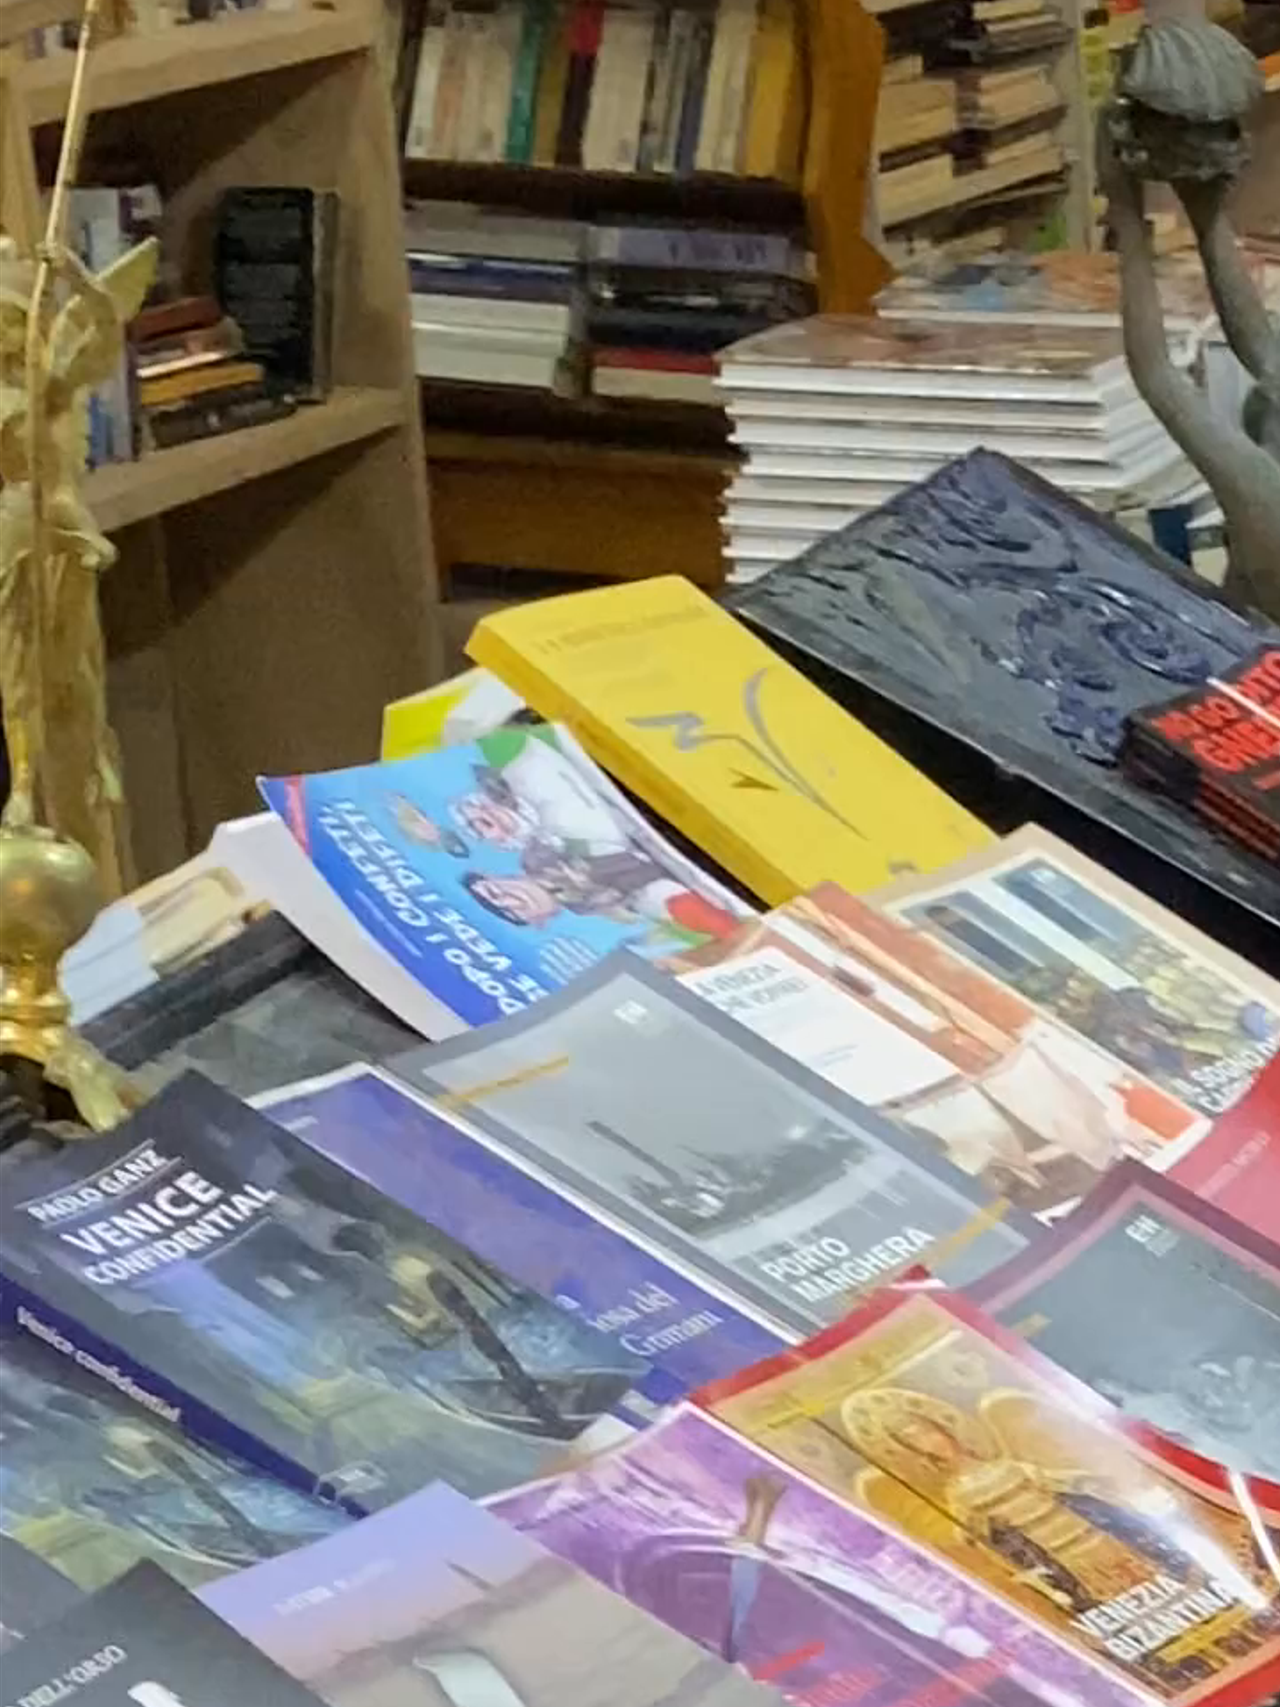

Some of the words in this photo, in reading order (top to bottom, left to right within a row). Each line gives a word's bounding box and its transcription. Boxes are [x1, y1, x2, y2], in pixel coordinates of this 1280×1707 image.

[434, 908, 512, 972] VEDE
[443, 947, 529, 1015] DOPO
[27, 1186, 104, 1222] PAOLO
[100, 1149, 170, 1194] GANZ
[60, 1171, 224, 1255] VENICE
[83, 1183, 278, 1285] CONFIDENTIAL
[759, 1234, 851, 1284] PORTO
[792, 1226, 936, 1303] MARGHERA
[1068, 1574, 1187, 1637] VENEZIA
